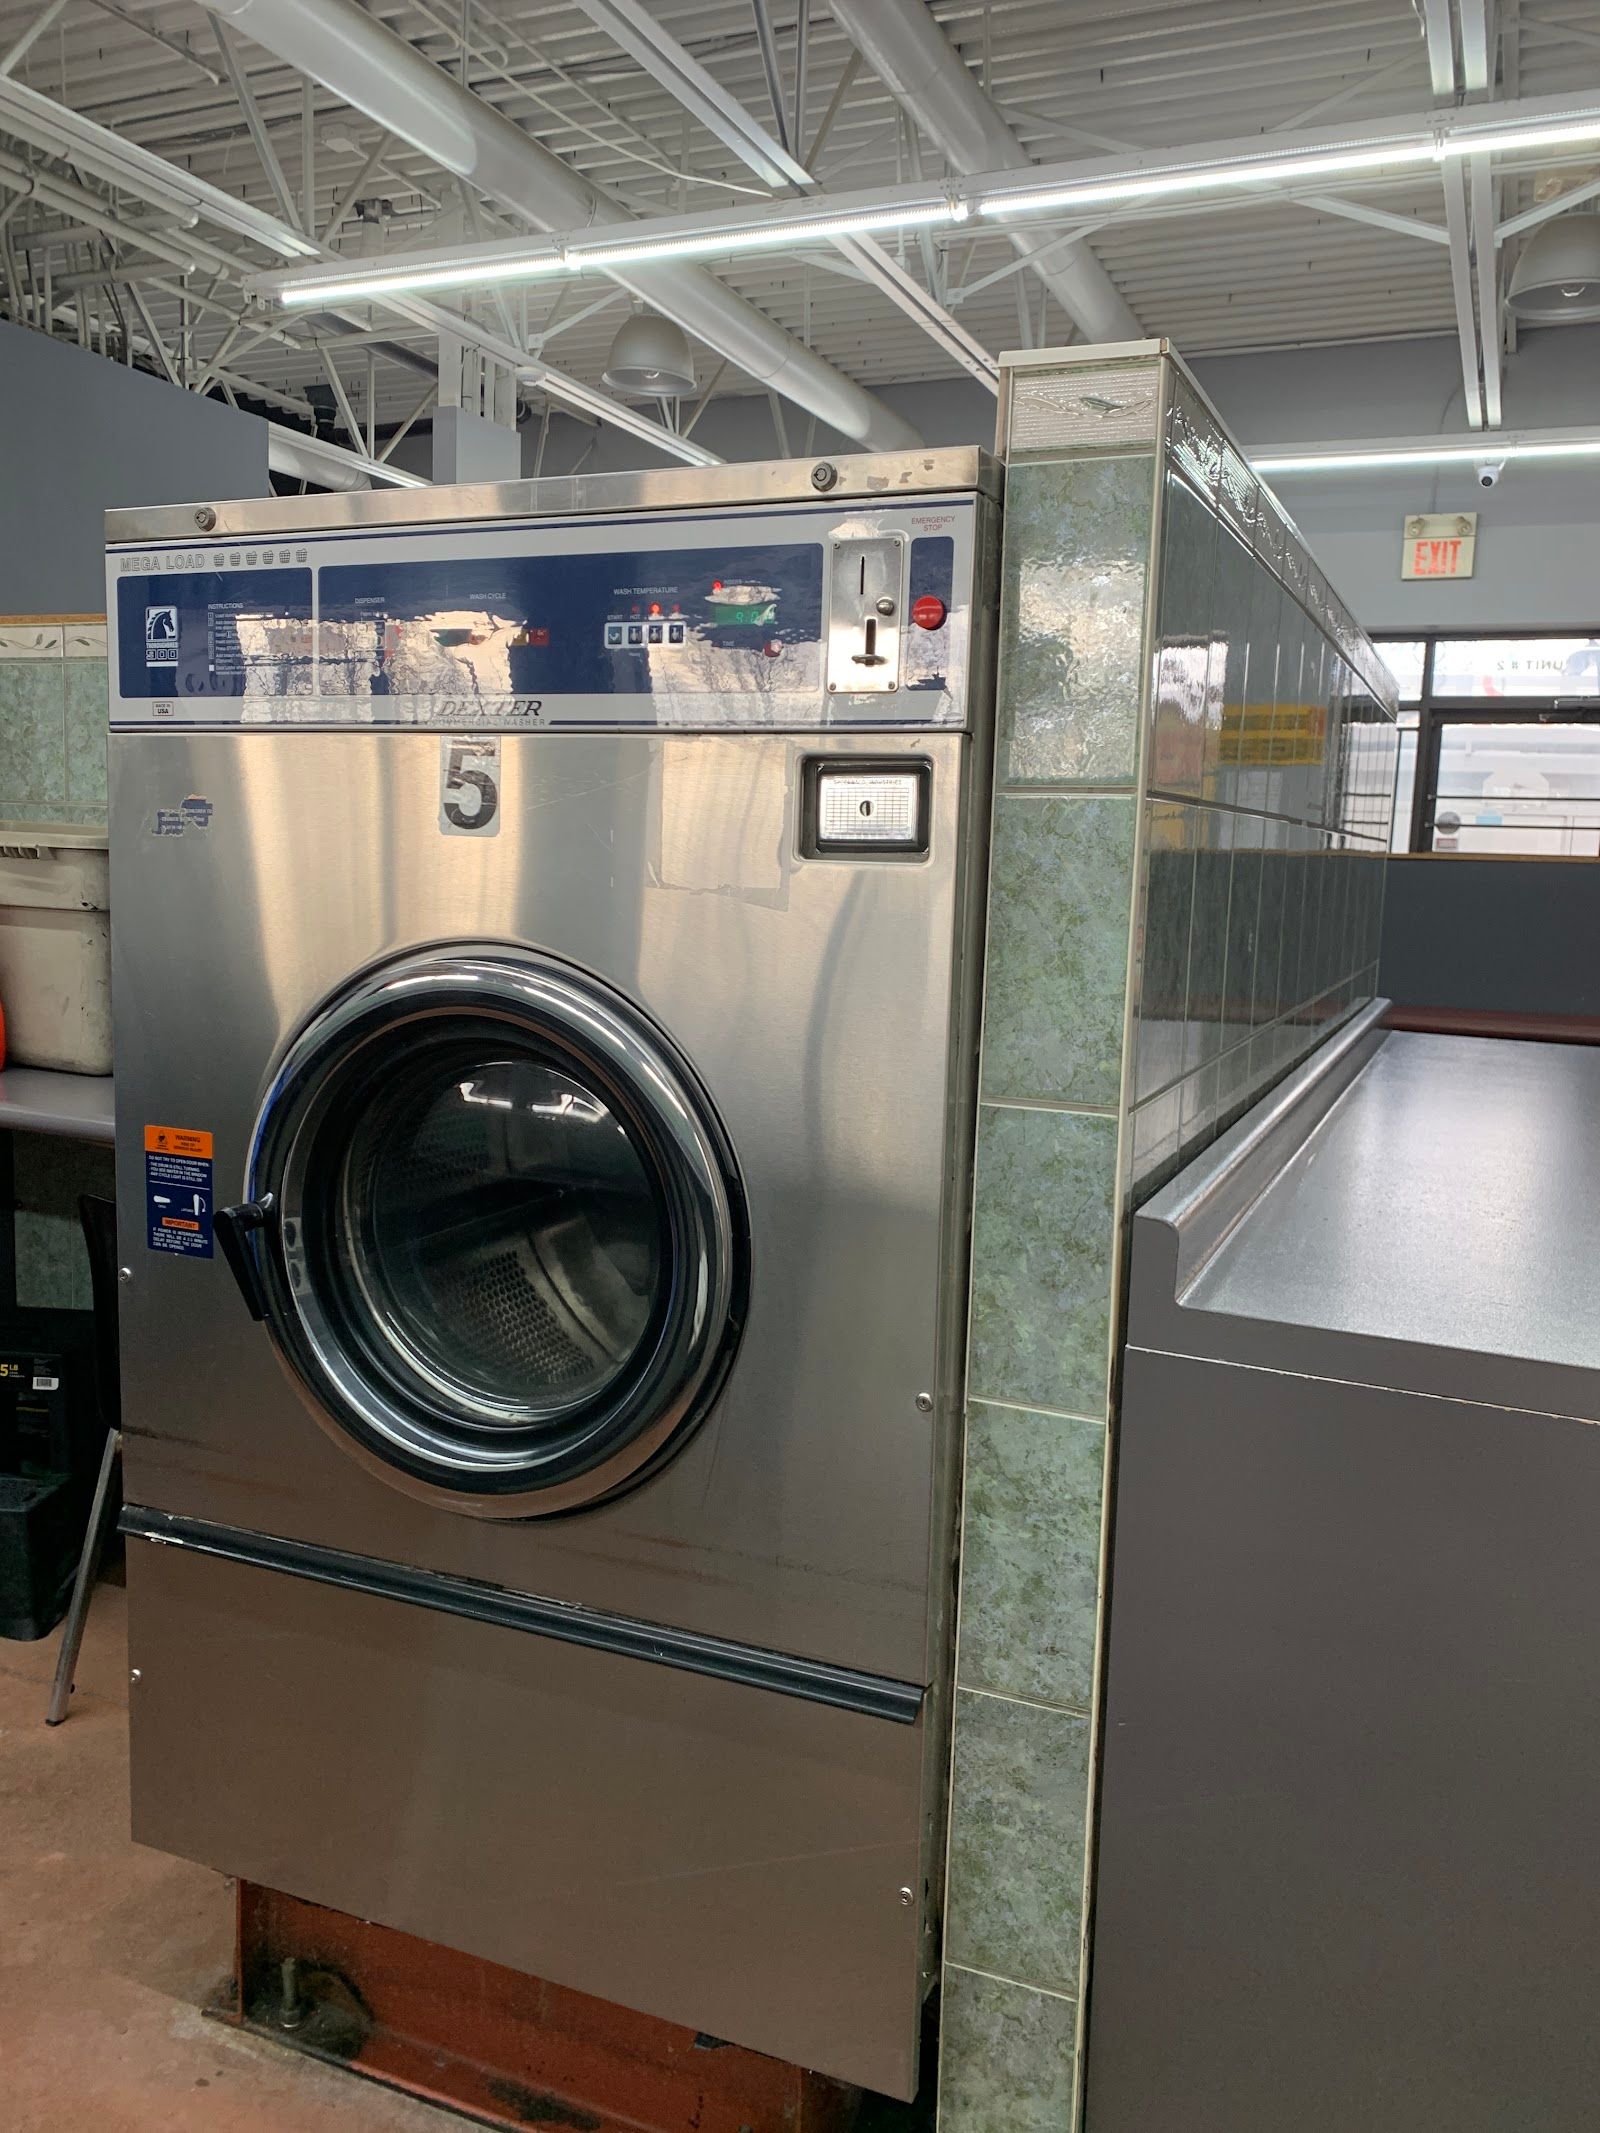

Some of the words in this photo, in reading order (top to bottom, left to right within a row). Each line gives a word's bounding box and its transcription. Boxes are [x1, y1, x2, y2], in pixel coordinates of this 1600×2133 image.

[911, 516, 955, 525] EMERGENCY
[923, 524, 943, 532] STOP
[120, 556, 160, 572] MEGA
[166, 553, 205, 569] LOAD
[1414, 540, 1462, 575] EXIT
[633, 586, 678, 595] TEMPERATURE
[354, 597, 385, 605] DISPENSER
[146, 649, 178, 660] 900
[437, 700, 542, 717] DEXTER
[503, 718, 546, 726] WASHER
[444, 740, 498, 830] 5
